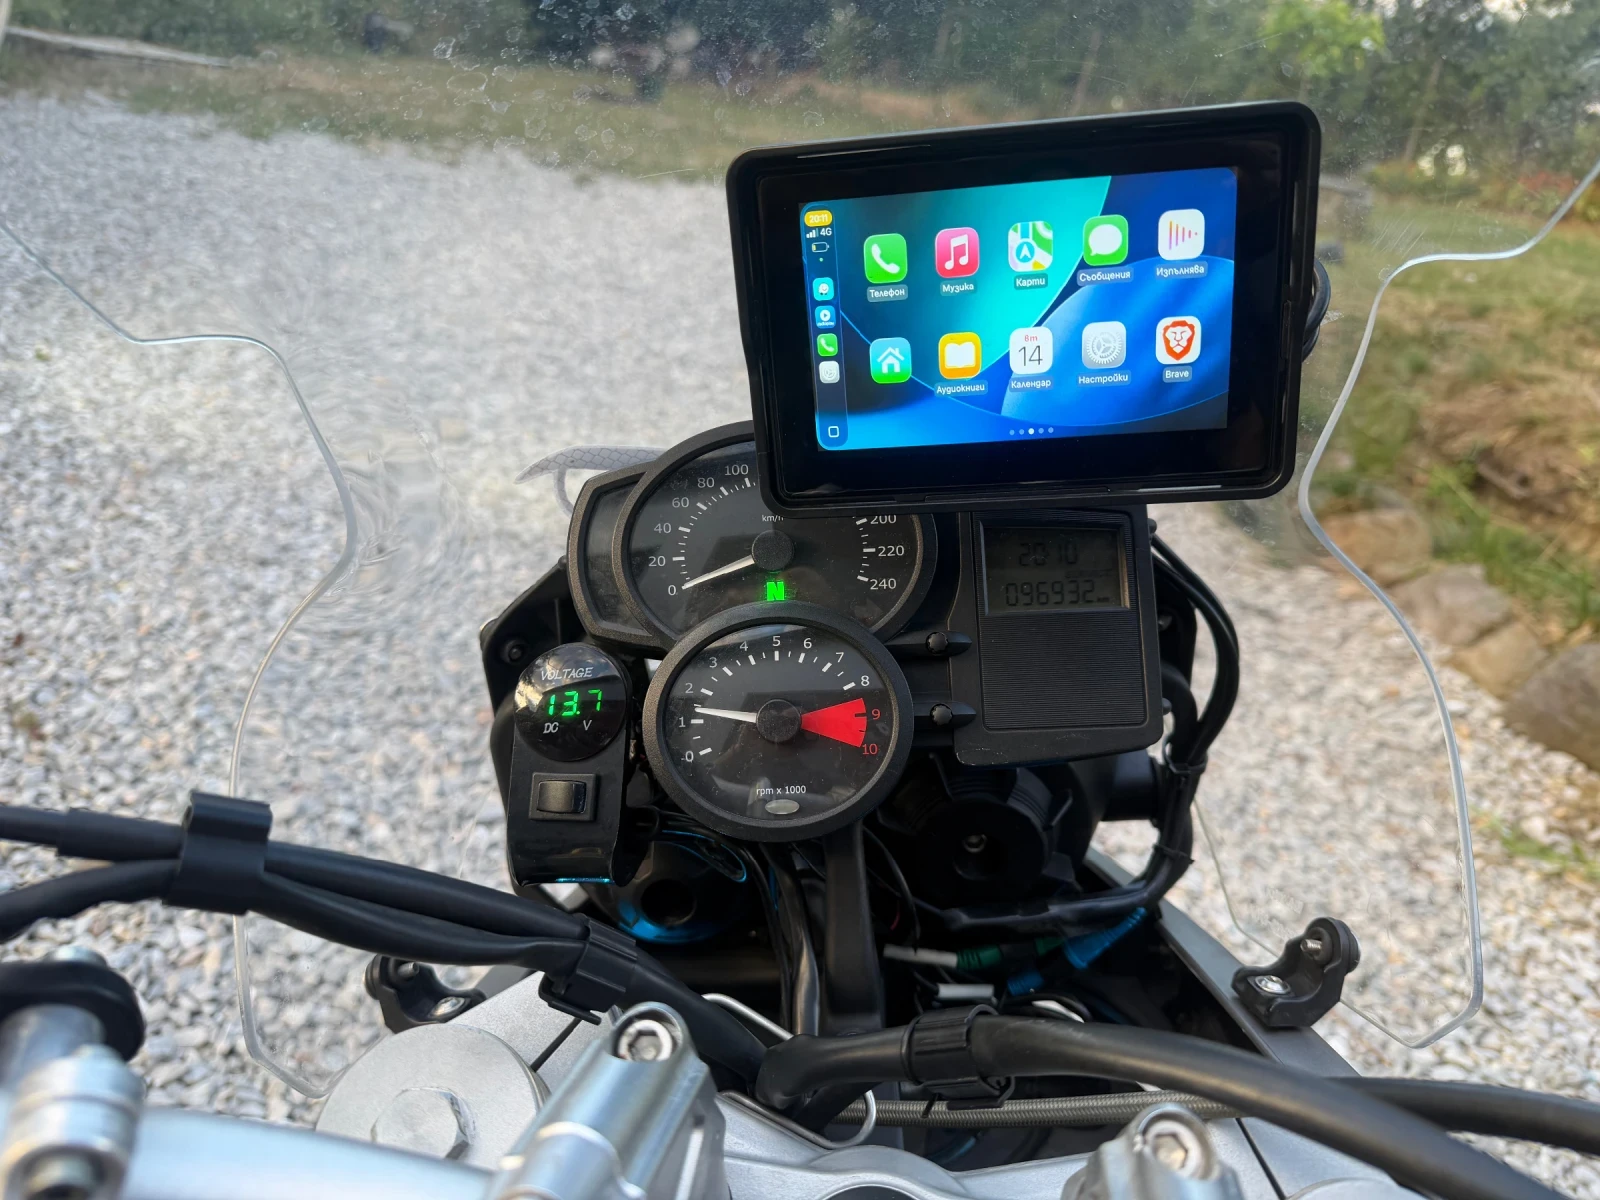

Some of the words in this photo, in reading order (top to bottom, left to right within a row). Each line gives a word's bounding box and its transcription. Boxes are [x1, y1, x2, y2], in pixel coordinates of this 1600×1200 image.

[809, 213, 828, 224] 20:11
[820, 227, 832, 236] 4G
[1156, 264, 1204, 277] Изпълнява
[1079, 270, 1131, 283] Съобщения
[942, 283, 974, 293] Музика
[1015, 277, 1045, 288] Карти
[869, 287, 905, 298] Телефон
[1018, 345, 1043, 367] 14
[1078, 373, 1128, 385] Настройки
[1165, 370, 1189, 379] Brave
[936, 383, 985, 395] Аудиокниги
[1011, 379, 1051, 389] Календар
[724, 464, 749, 475] 100
[697, 477, 715, 488] 80
[671, 497, 690, 508] 60
[870, 514, 897, 524] 200
[653, 523, 672, 534] 40
[878, 545, 905, 557] 220
[648, 556, 666, 567] 20
[667, 584, 677, 596] 0
[870, 579, 897, 590] 240
[766, 582, 785, 600] N
[739, 641, 749, 651] 4
[772, 635, 781, 647] 5
[803, 638, 812, 649] 6
[709, 657, 718, 668] 3
[835, 652, 845, 662] 7
[541, 667, 594, 680] VOLTAGE
[860, 675, 870, 686] 8
[685, 683, 694, 694] 2
[548, 689, 603, 716] 13.7
[871, 709, 881, 720] 9
[583, 720, 592, 731] V
[678, 717, 686, 727] 1
[543, 722, 559, 734] DC
[862, 744, 878, 755] 10
[685, 751, 694, 762] 0
[756, 786, 774, 797] rpm
[785, 785, 807, 794] 1000
